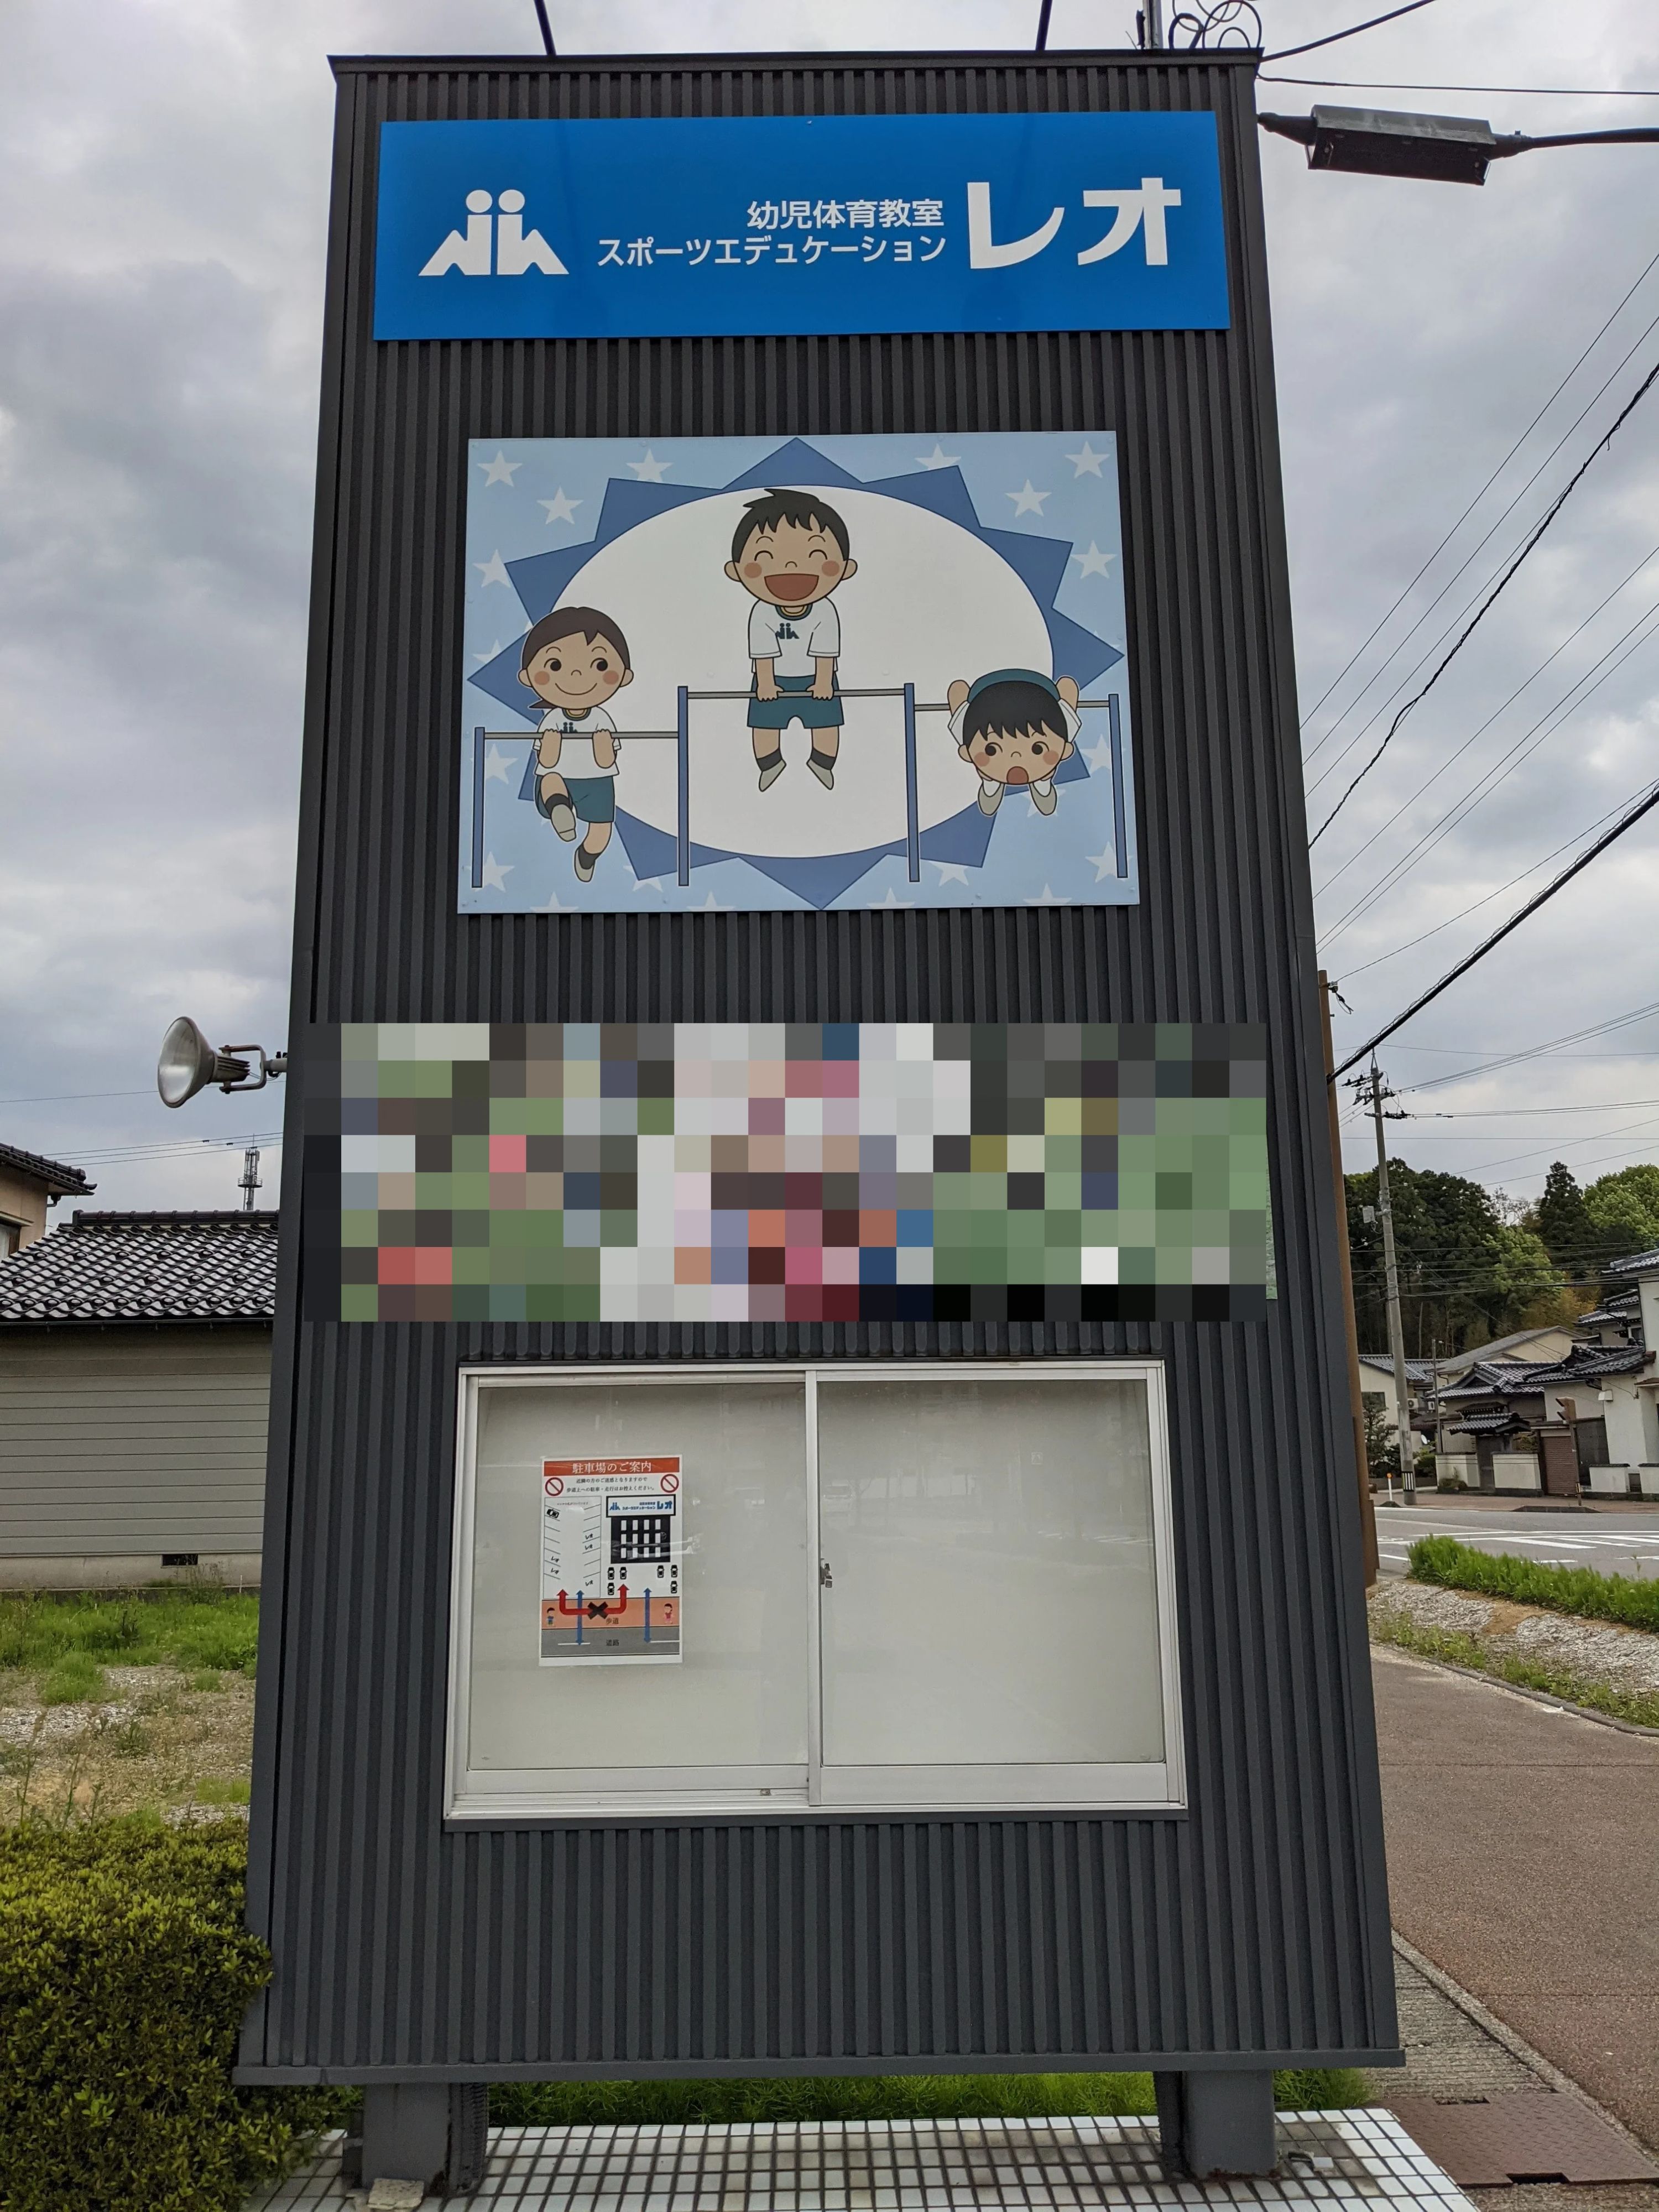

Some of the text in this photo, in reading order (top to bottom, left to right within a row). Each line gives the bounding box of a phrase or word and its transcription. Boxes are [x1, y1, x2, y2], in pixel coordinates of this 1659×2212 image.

[747, 199, 944, 229] 幼児体育教室
[967, 178, 1182, 269] レオ
[598, 235, 946, 267] スポーツエデュケーション
[572, 1461, 651, 1474] 駐車場のご案内
[657, 1500, 672, 1510] レオ
